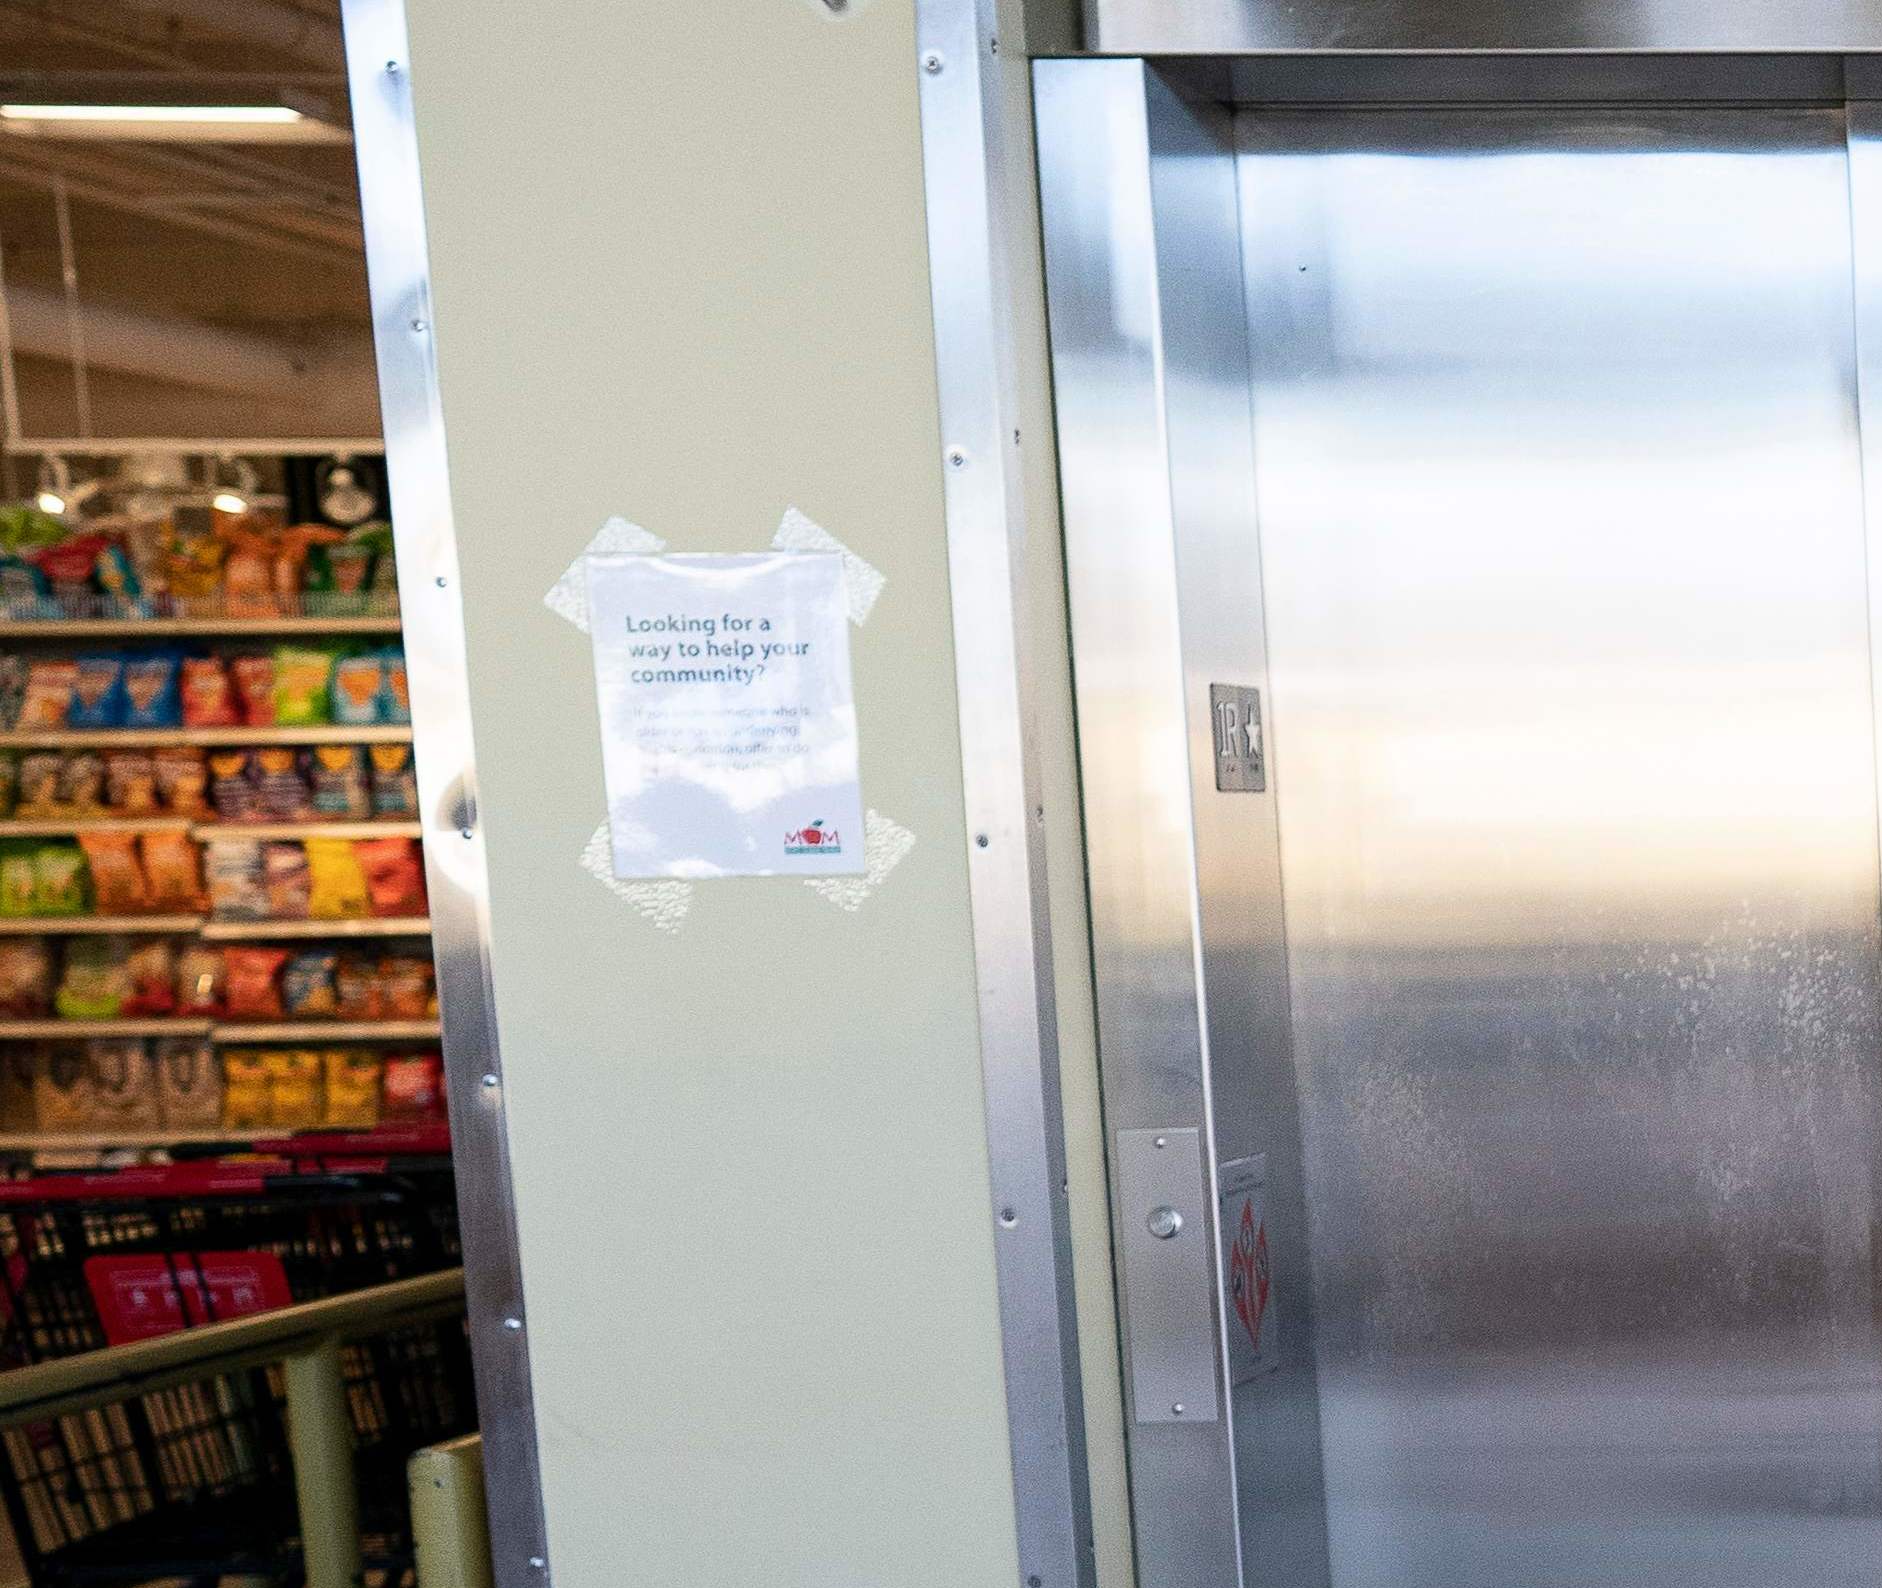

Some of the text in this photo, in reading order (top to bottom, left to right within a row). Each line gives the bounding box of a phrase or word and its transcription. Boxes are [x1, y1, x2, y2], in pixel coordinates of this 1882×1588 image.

[626, 613, 770, 636] Looking for a
[629, 640, 809, 661] way to help your
[631, 664, 765, 685] community?
